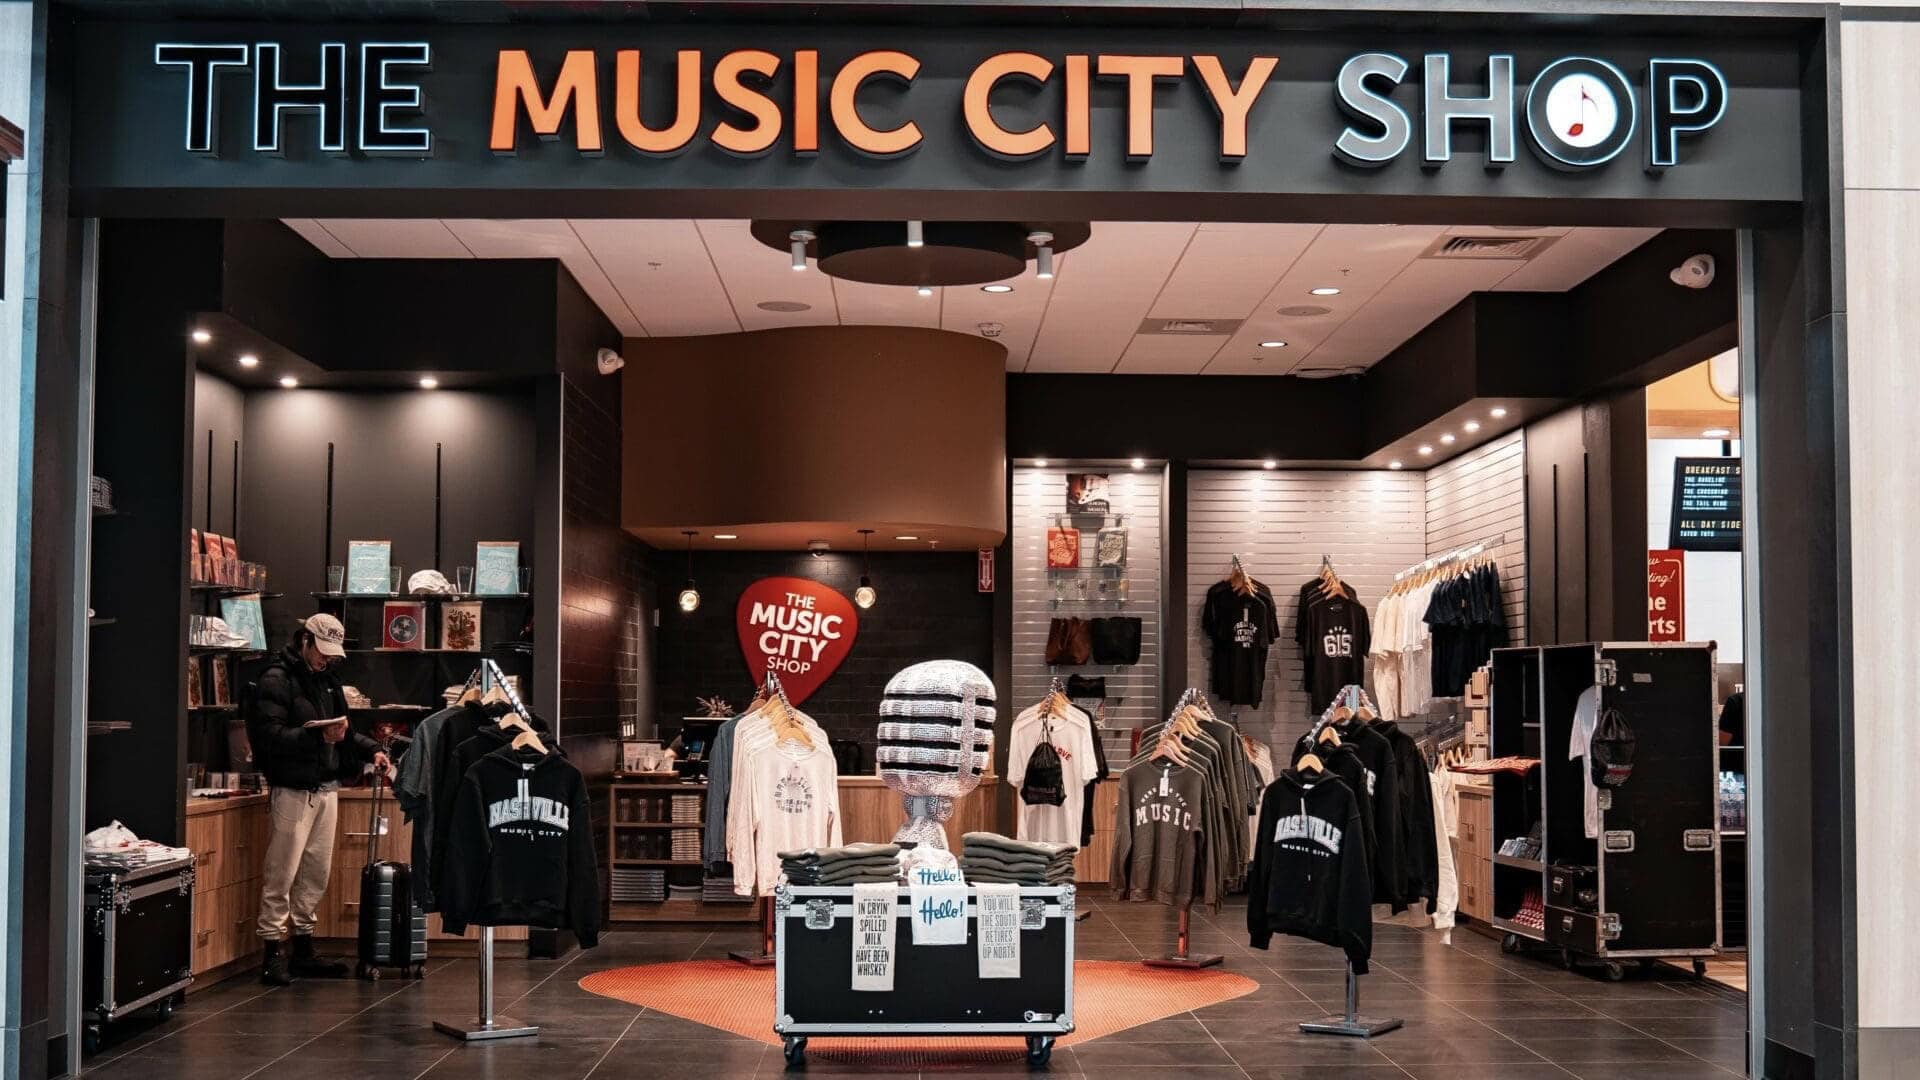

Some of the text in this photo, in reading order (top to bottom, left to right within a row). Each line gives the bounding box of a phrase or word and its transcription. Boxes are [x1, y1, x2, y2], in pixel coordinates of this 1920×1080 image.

[155, 43, 1728, 168] THE MUSIC CITY SHOP
[1685, 466, 1730, 474] BREAKFAST
[785, 592, 816, 610] THE
[750, 602, 842, 640] MUSIC
[759, 631, 828, 662] CITY
[1323, 634, 1352, 657] 615
[767, 656, 811, 674] SHOP
[489, 796, 569, 831] NASHVILLE
[1136, 803, 1191, 831] MUSIC
[1274, 814, 1342, 854] NASHVILLE
[1281, 843, 1331, 858] MUSIC CITY
[917, 868, 961, 885] Hello!
[858, 902, 866, 915] IN
[919, 896, 963, 925] Hello!
[983, 897, 1014, 911] YOU WILL
[859, 919, 887, 932] SPILLED
[981, 913, 1017, 926] THE SOUTH
[864, 932, 882, 945] MILK
[985, 930, 1013, 943] RETIRES
[856, 950, 889, 962] HAVE BEEN
[982, 945, 1016, 959] UP NORTH
[857, 963, 887, 976] WHISKEY
